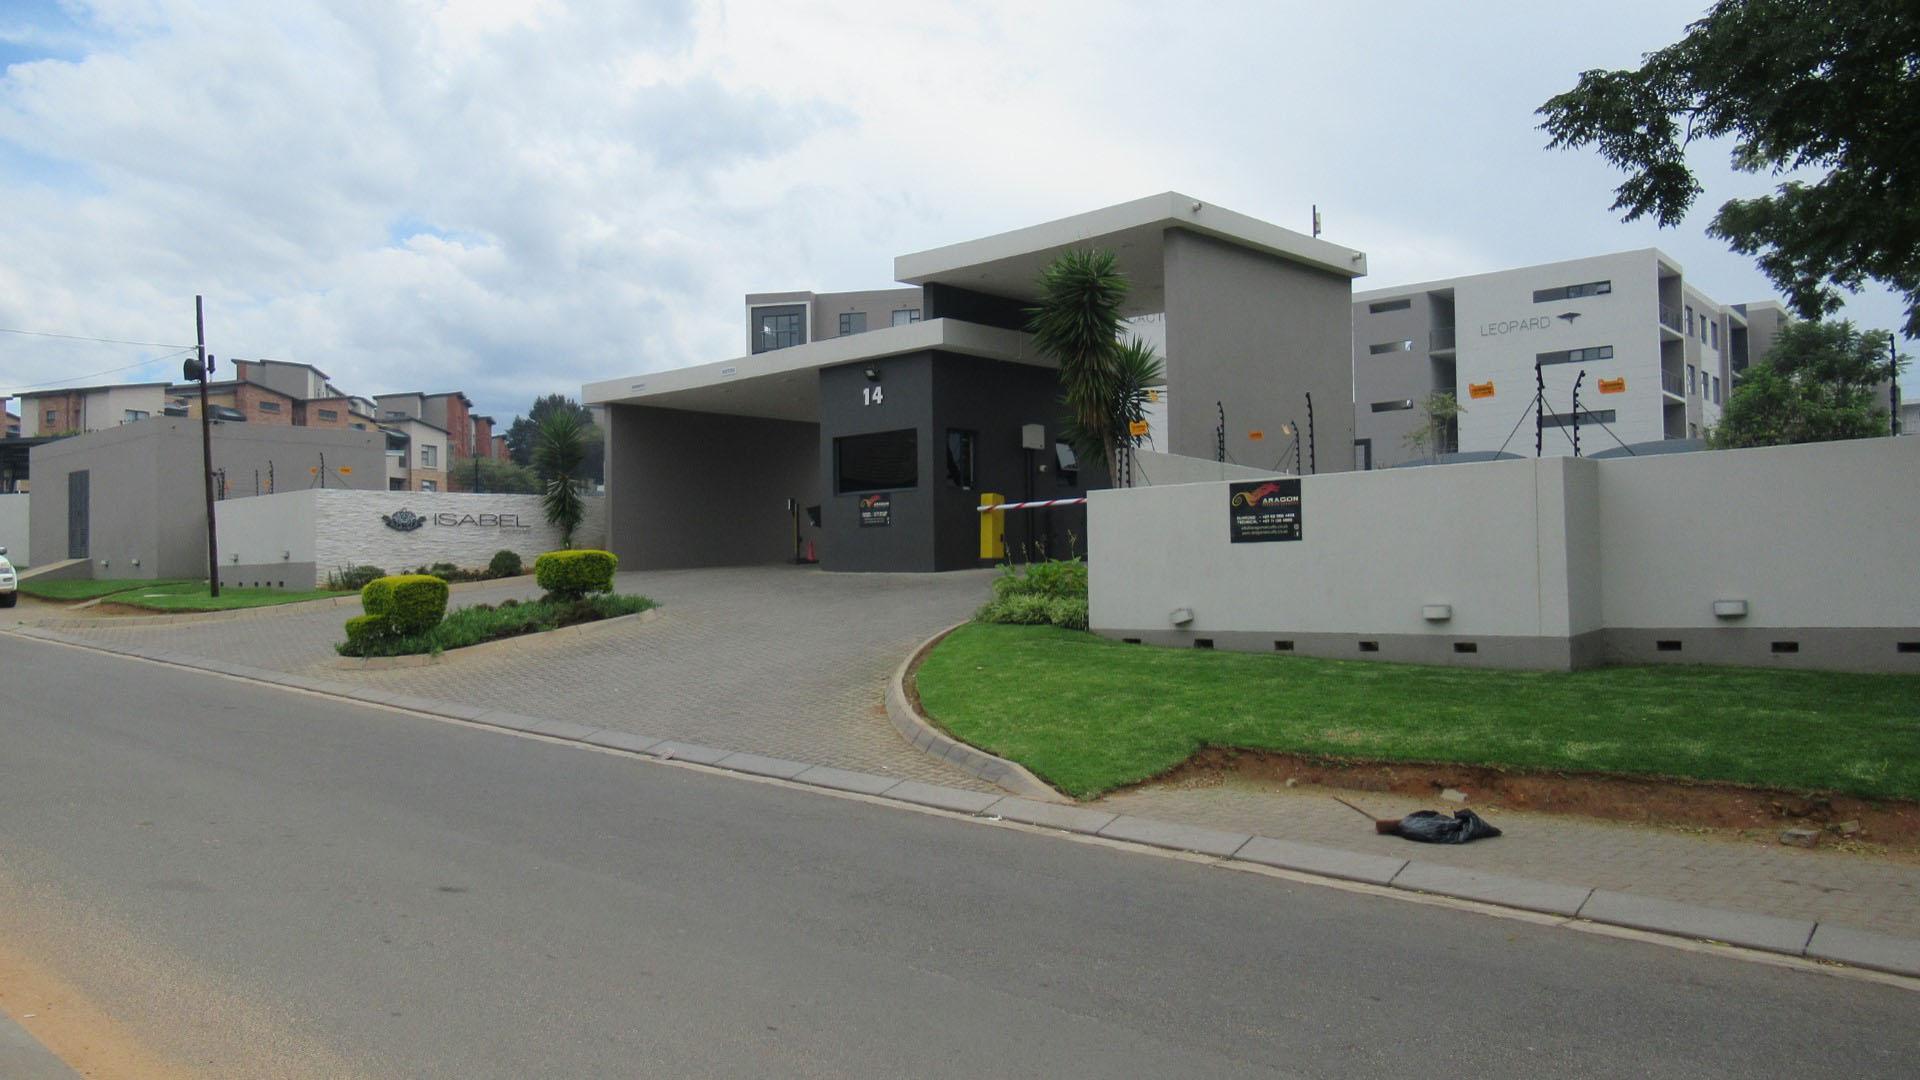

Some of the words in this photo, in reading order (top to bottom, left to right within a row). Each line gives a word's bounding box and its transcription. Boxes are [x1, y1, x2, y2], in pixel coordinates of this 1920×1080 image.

[1480, 316, 1551, 337] LEOPARD
[863, 386, 884, 406] 14
[1262, 496, 1299, 504] ARAGON
[433, 513, 531, 528] ISABEL
